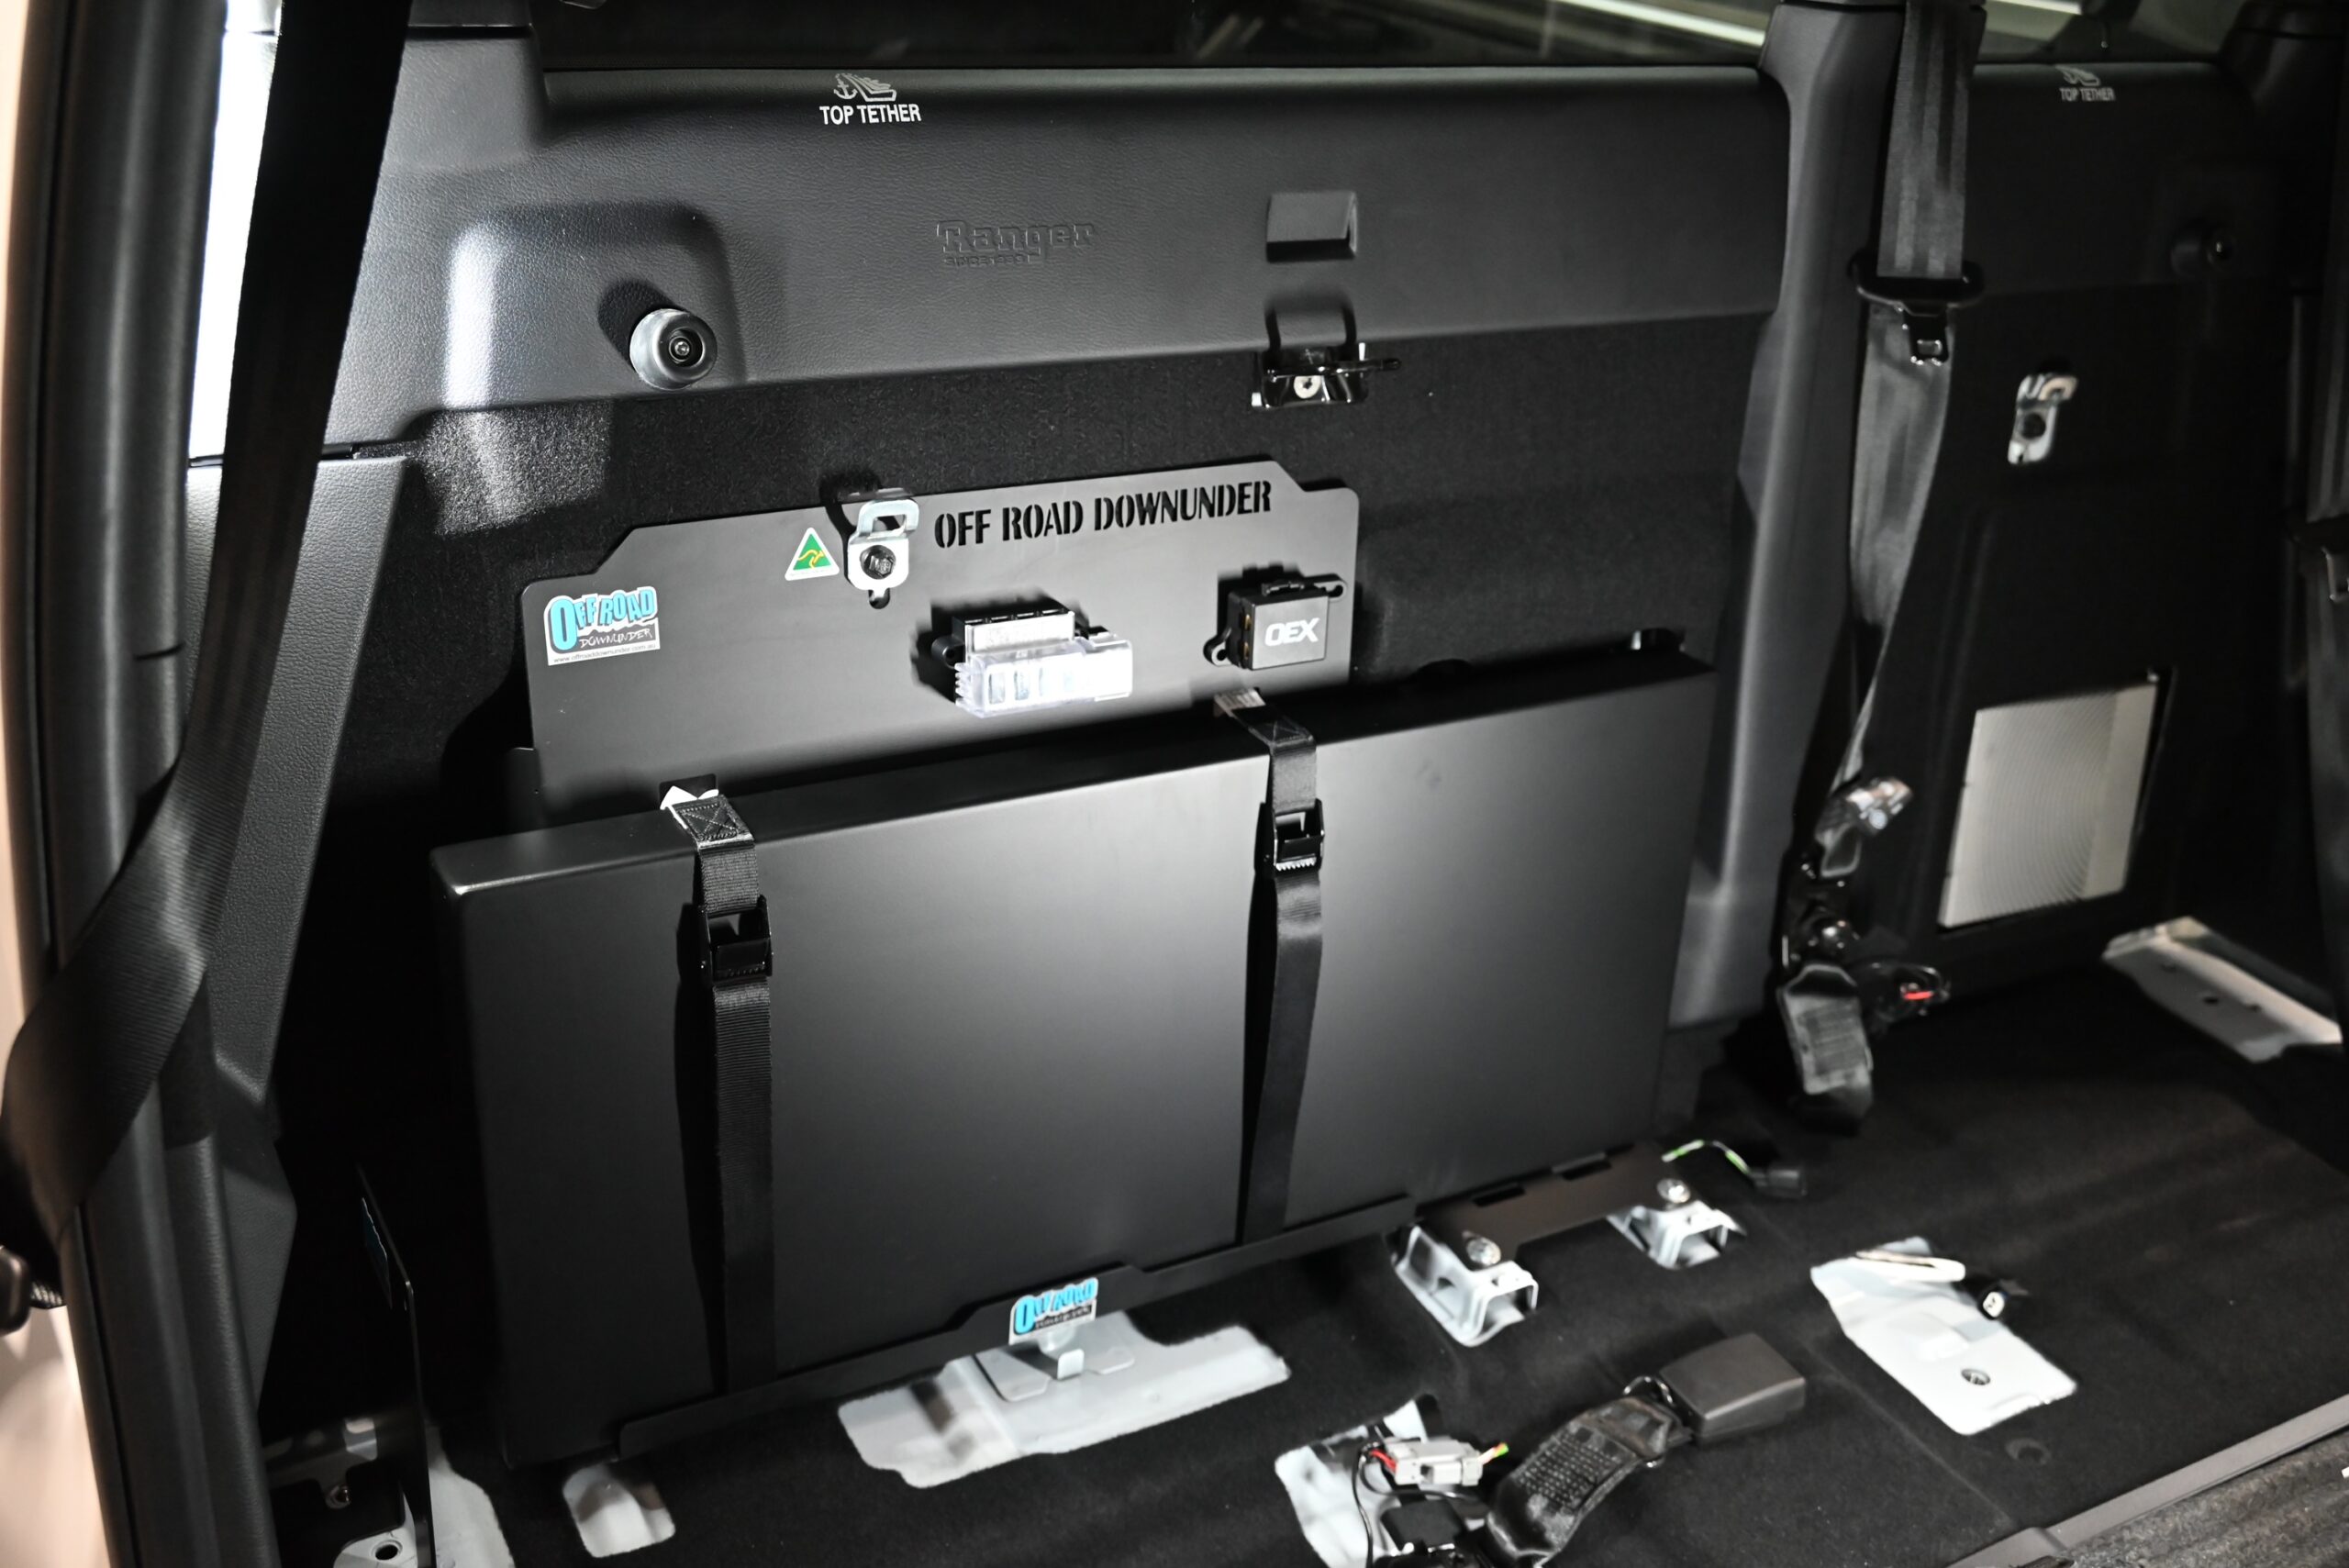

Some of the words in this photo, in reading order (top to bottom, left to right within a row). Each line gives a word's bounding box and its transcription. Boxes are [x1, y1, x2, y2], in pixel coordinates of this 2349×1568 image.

[2059, 87, 2078, 102] TOP
[2079, 86, 2115, 102] TETHER
[819, 106, 854, 125] TOP
[856, 104, 922, 124] TETHER
[934, 509, 991, 549] OFF
[1002, 500, 1084, 541] ROAD
[1094, 480, 1272, 531] DOWNUNDER
[579, 628, 653, 649] DOWNUNDER
[1264, 617, 1319, 647] OEX
